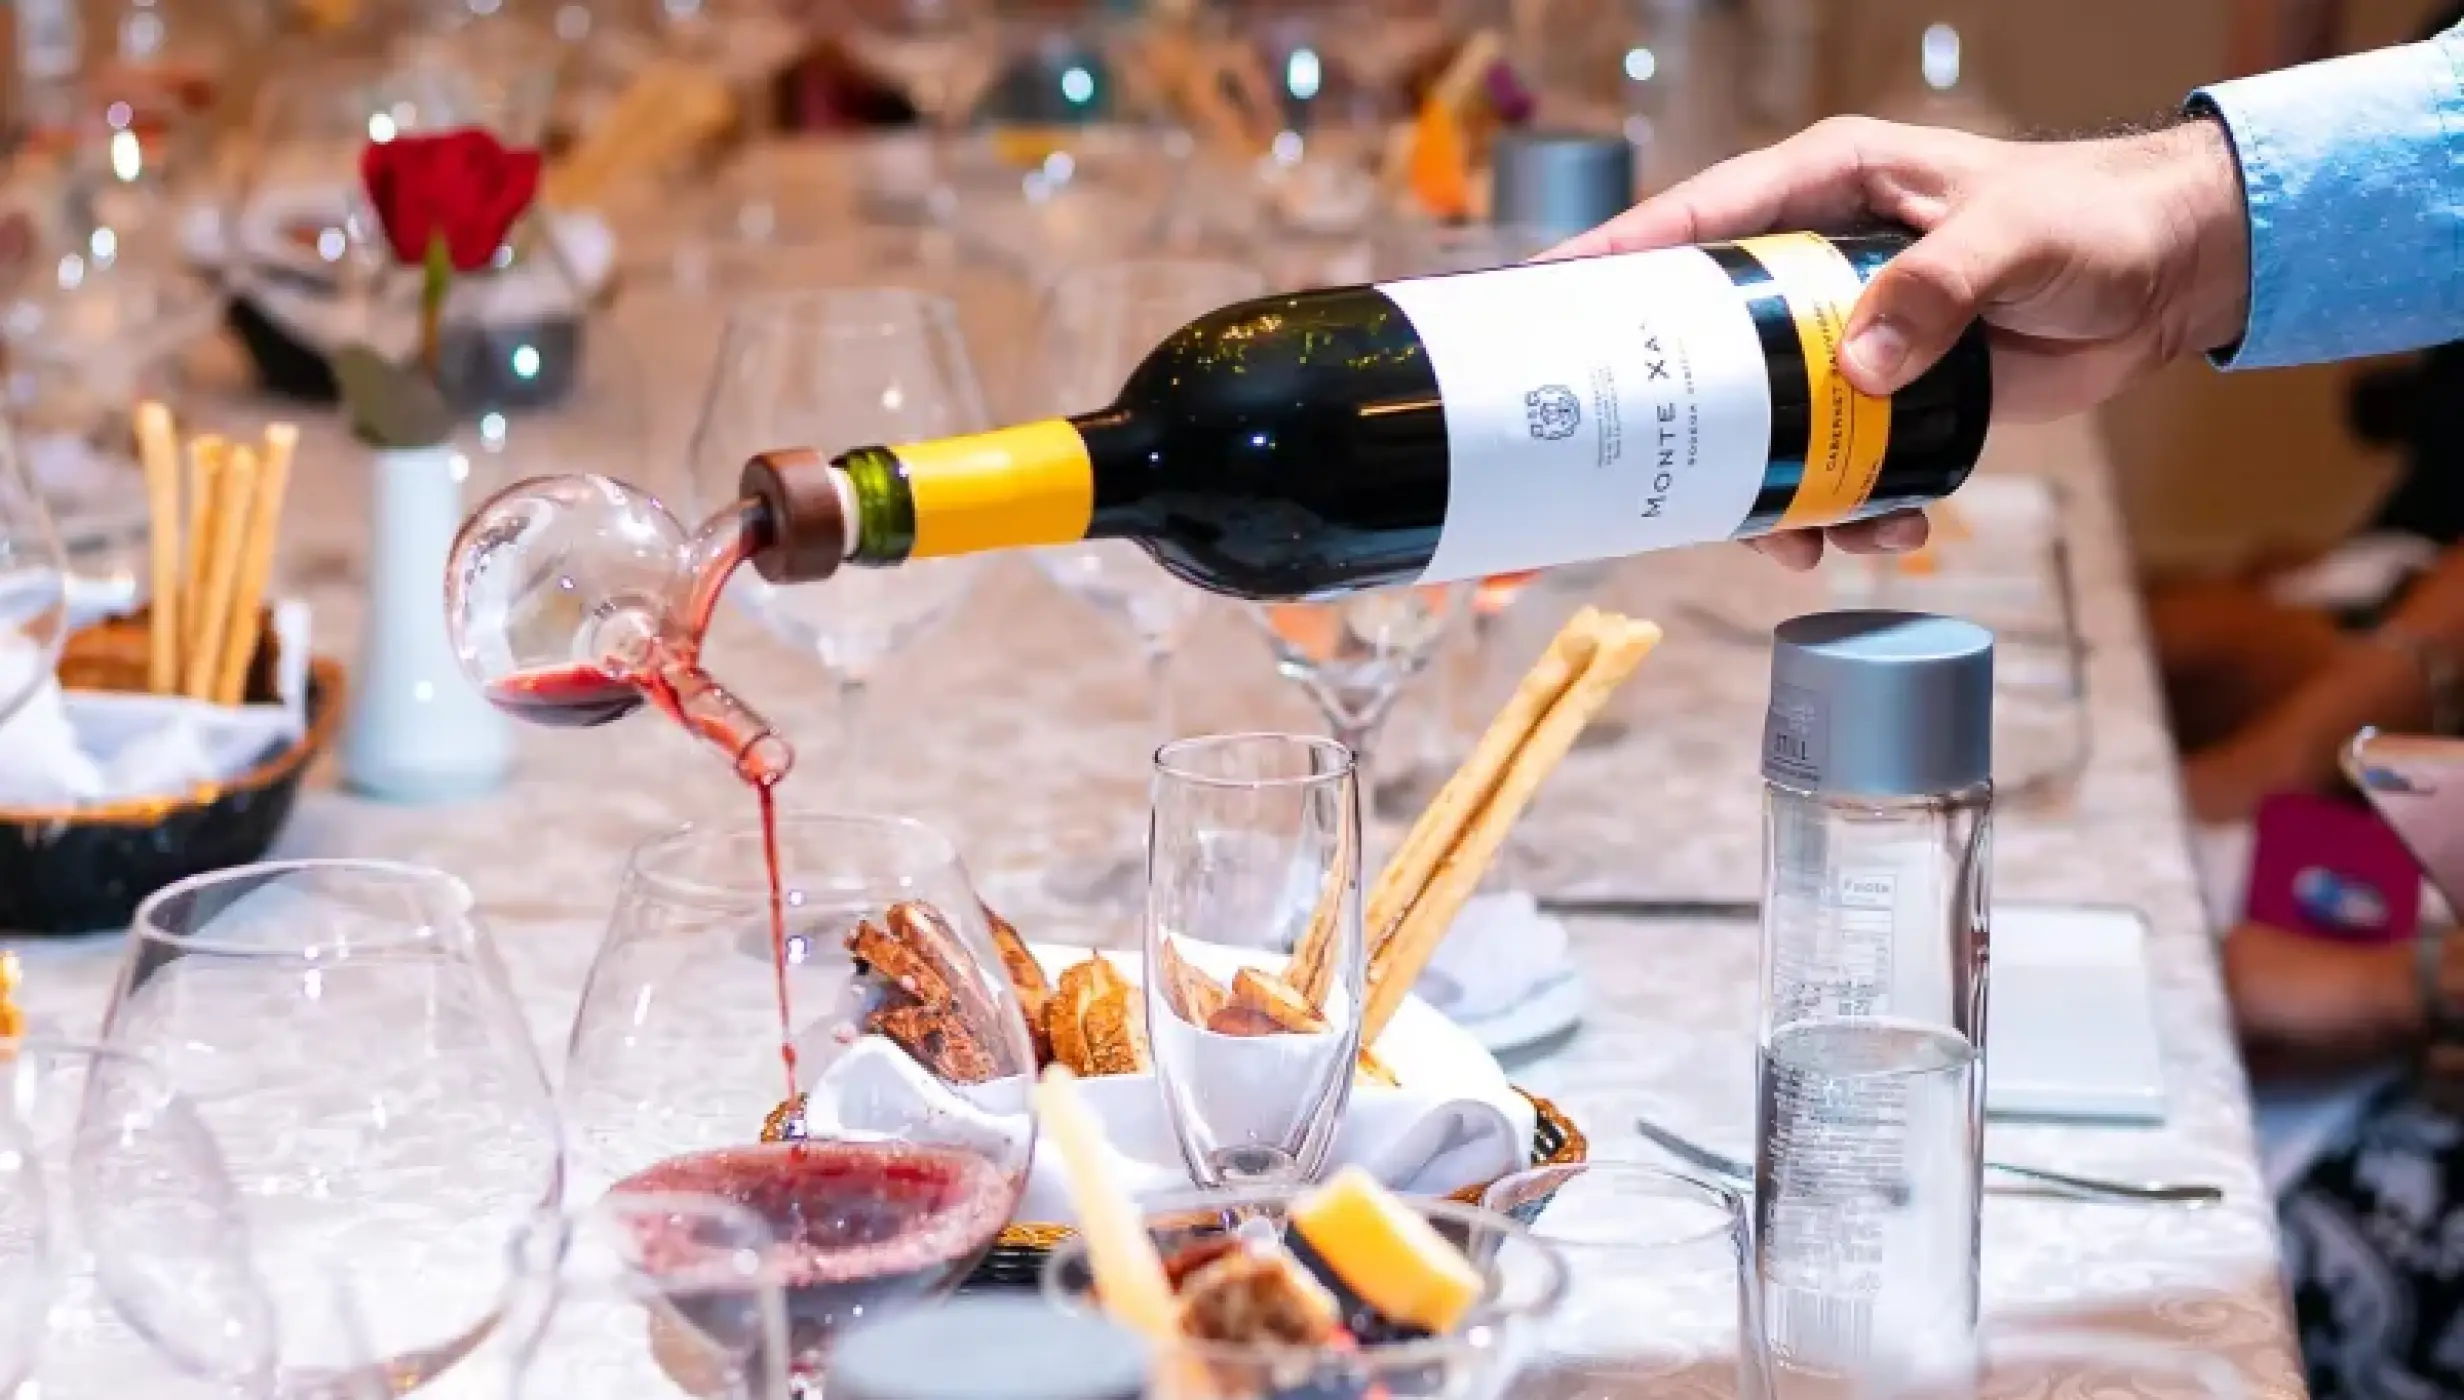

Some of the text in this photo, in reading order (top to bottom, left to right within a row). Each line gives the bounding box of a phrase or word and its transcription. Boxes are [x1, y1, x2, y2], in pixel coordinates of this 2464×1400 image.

[1638, 317, 1676, 519] MONTE XA
[1824, 386, 1843, 472] CABERNET
